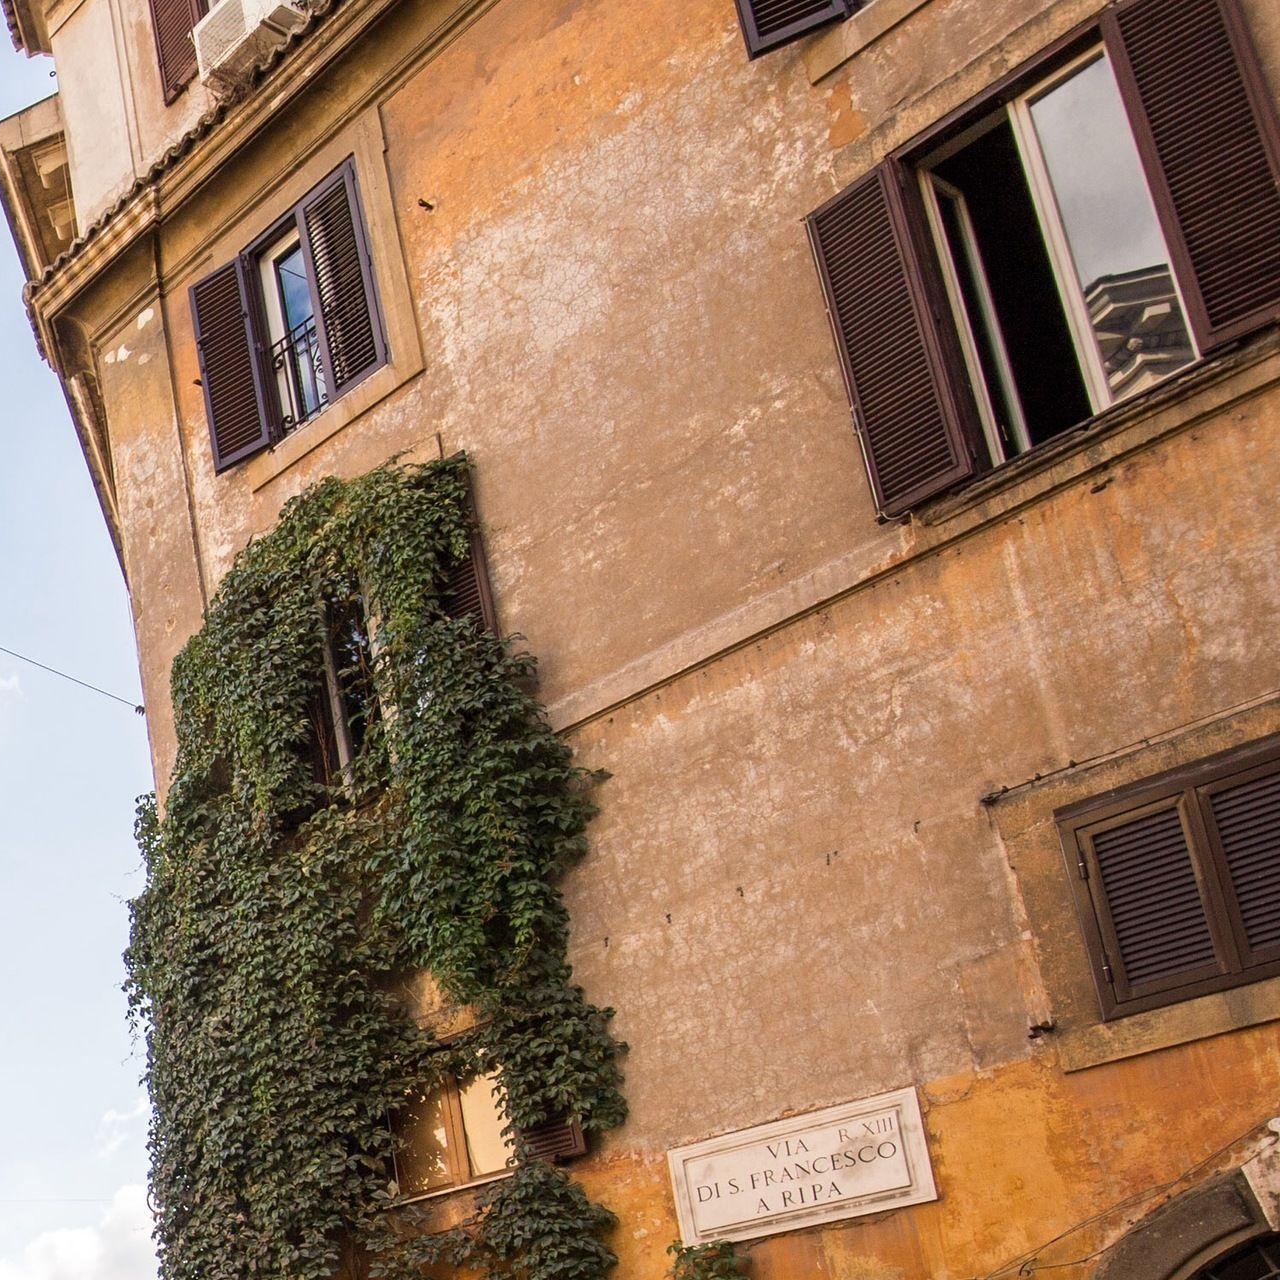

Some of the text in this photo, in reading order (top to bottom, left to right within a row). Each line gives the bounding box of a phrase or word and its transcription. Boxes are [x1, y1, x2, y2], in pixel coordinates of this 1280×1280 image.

[862, 1117, 894, 1136] XIII
[766, 1138, 809, 1159] VIA
[697, 1141, 897, 1202] DI S. FRANCESCO
[757, 1182, 842, 1214] A RIPA
